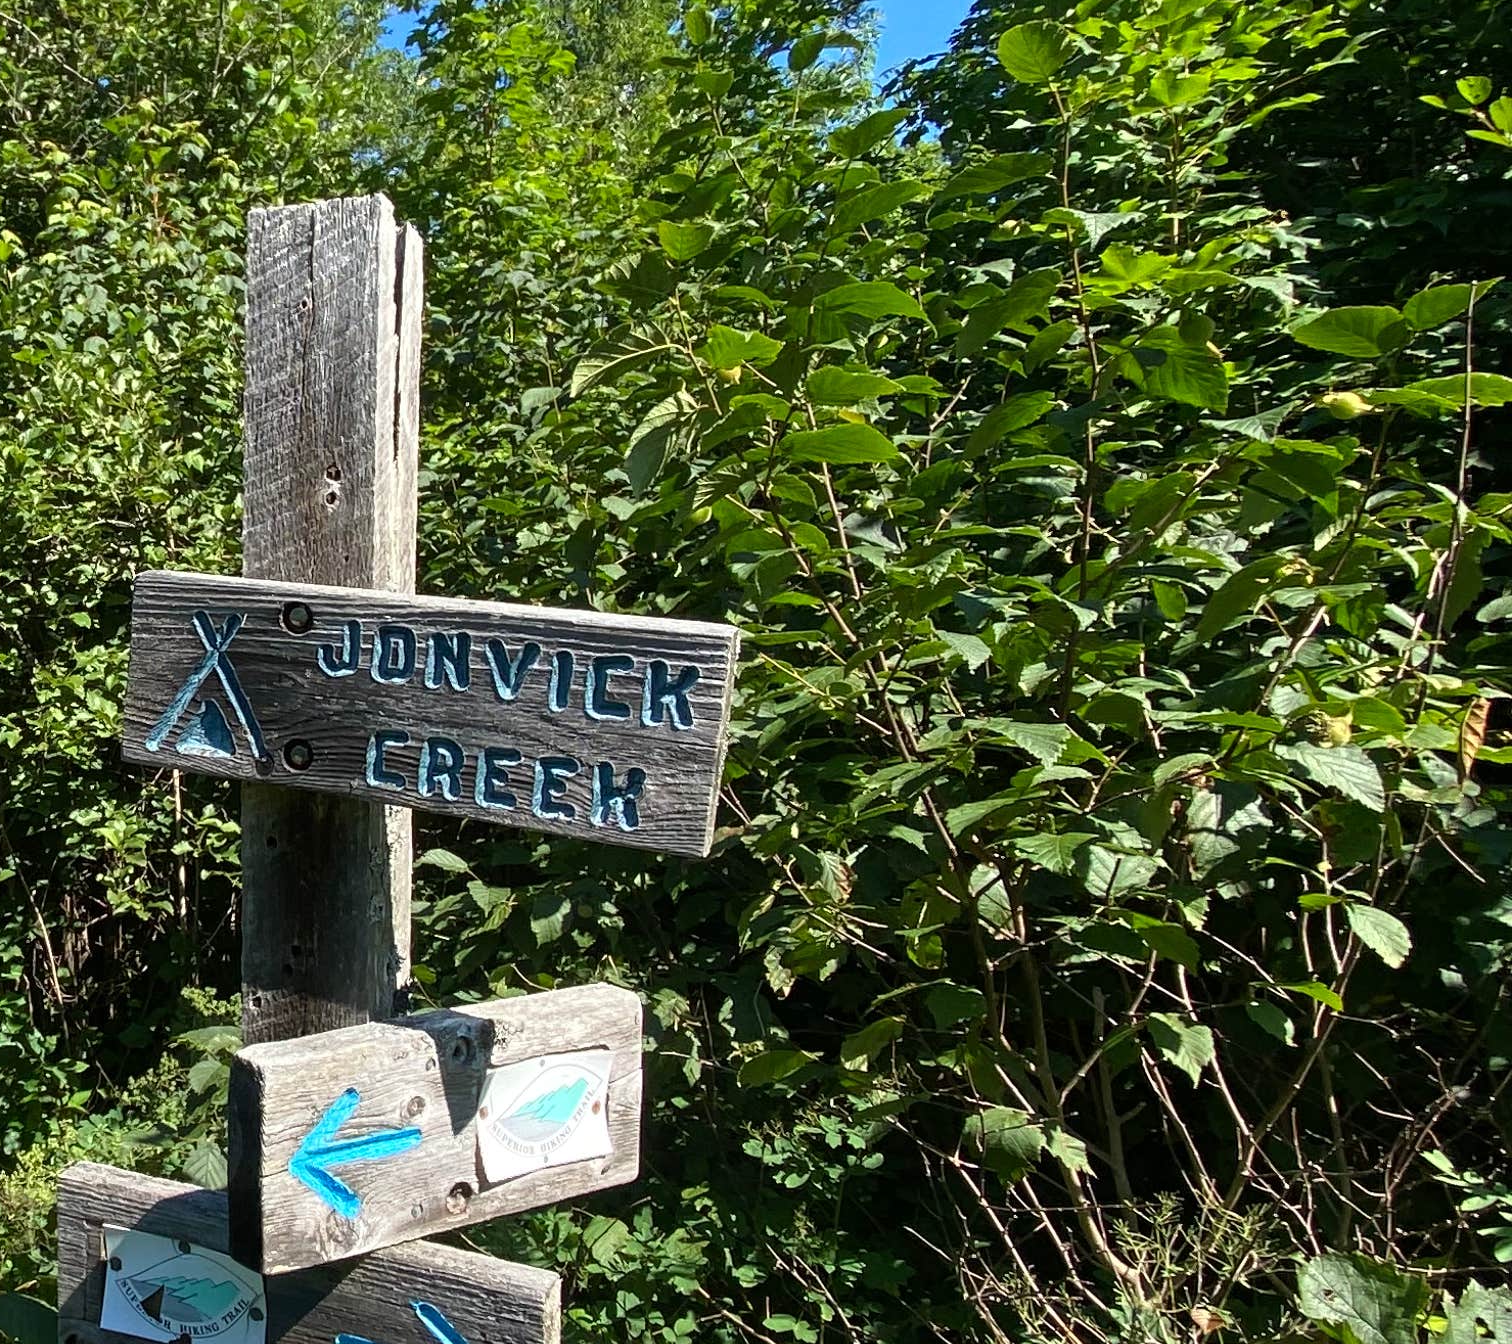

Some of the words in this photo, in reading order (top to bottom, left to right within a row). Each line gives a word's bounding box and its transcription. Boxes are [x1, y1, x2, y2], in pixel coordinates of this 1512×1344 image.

[316, 619, 700, 731] JONVICK
[365, 730, 647, 832] CREEK
[491, 1123, 535, 1155] SUPERIOR
[540, 1125, 572, 1153] HIKING
[572, 1089, 597, 1122] TRAIL
[120, 1279, 172, 1330] SUPR
[179, 1321, 220, 1336] HIKING
[221, 1298, 249, 1325] TRAIL
